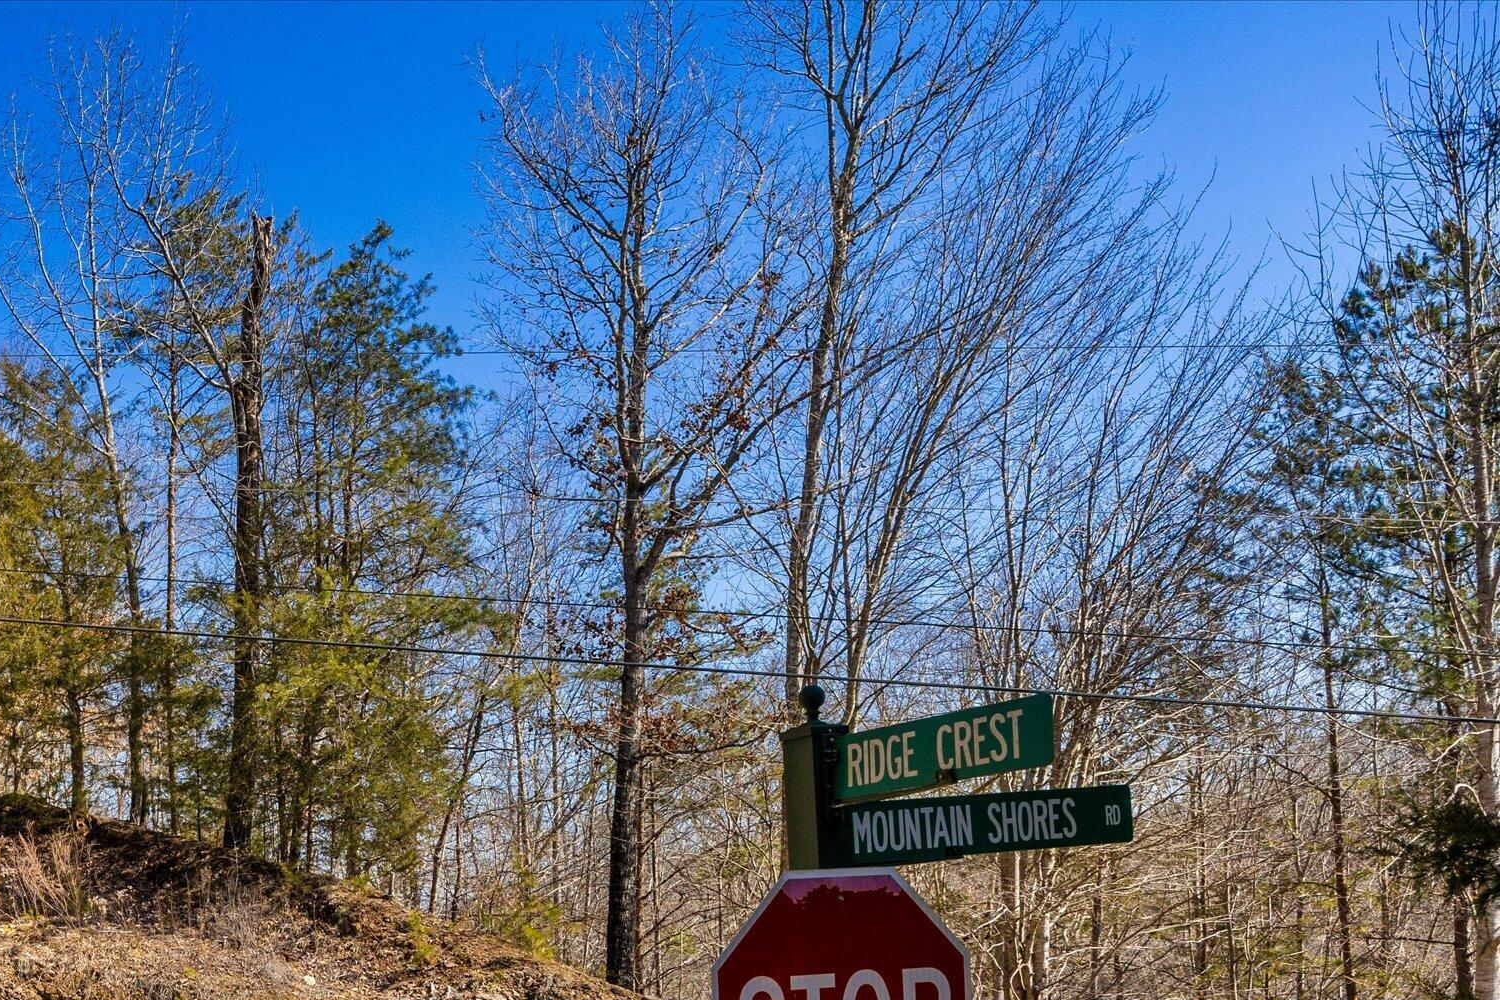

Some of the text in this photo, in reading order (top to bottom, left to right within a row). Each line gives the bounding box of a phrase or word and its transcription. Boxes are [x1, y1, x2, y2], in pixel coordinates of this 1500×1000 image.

[847, 708, 1024, 788] RIDGE CREST
[852, 797, 1121, 855] MOUNTAIN SHORES RD
